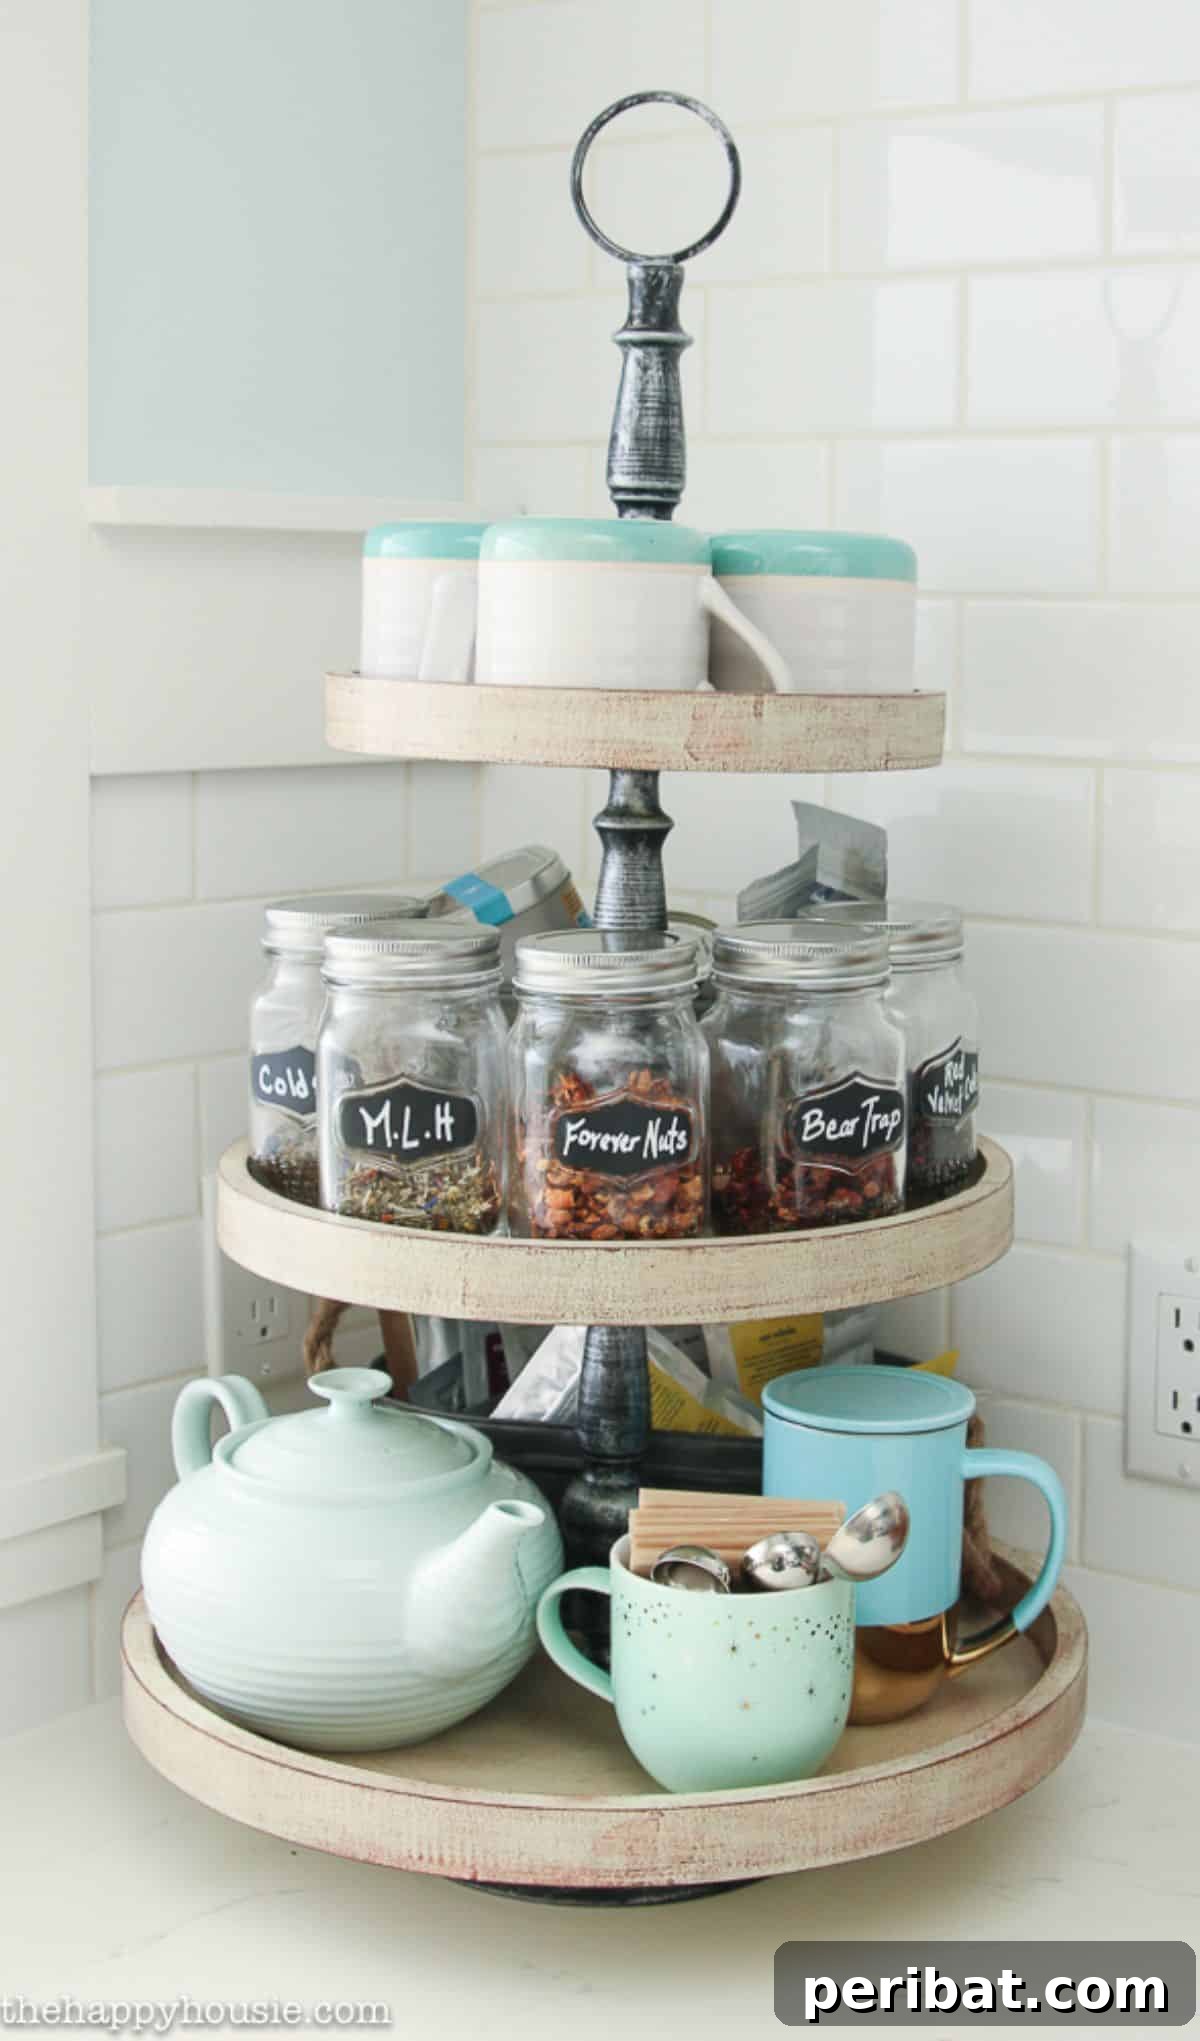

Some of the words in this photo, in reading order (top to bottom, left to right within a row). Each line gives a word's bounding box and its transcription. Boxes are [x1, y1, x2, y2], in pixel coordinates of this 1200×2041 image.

[259, 1064, 309, 1099] Cold
[359, 1100, 454, 1149] M.L.H
[563, 1117, 641, 1157] Forever
[642, 1116, 687, 1159] Nuts
[801, 1108, 860, 1142] Bear
[860, 1095, 901, 1149] Trap
